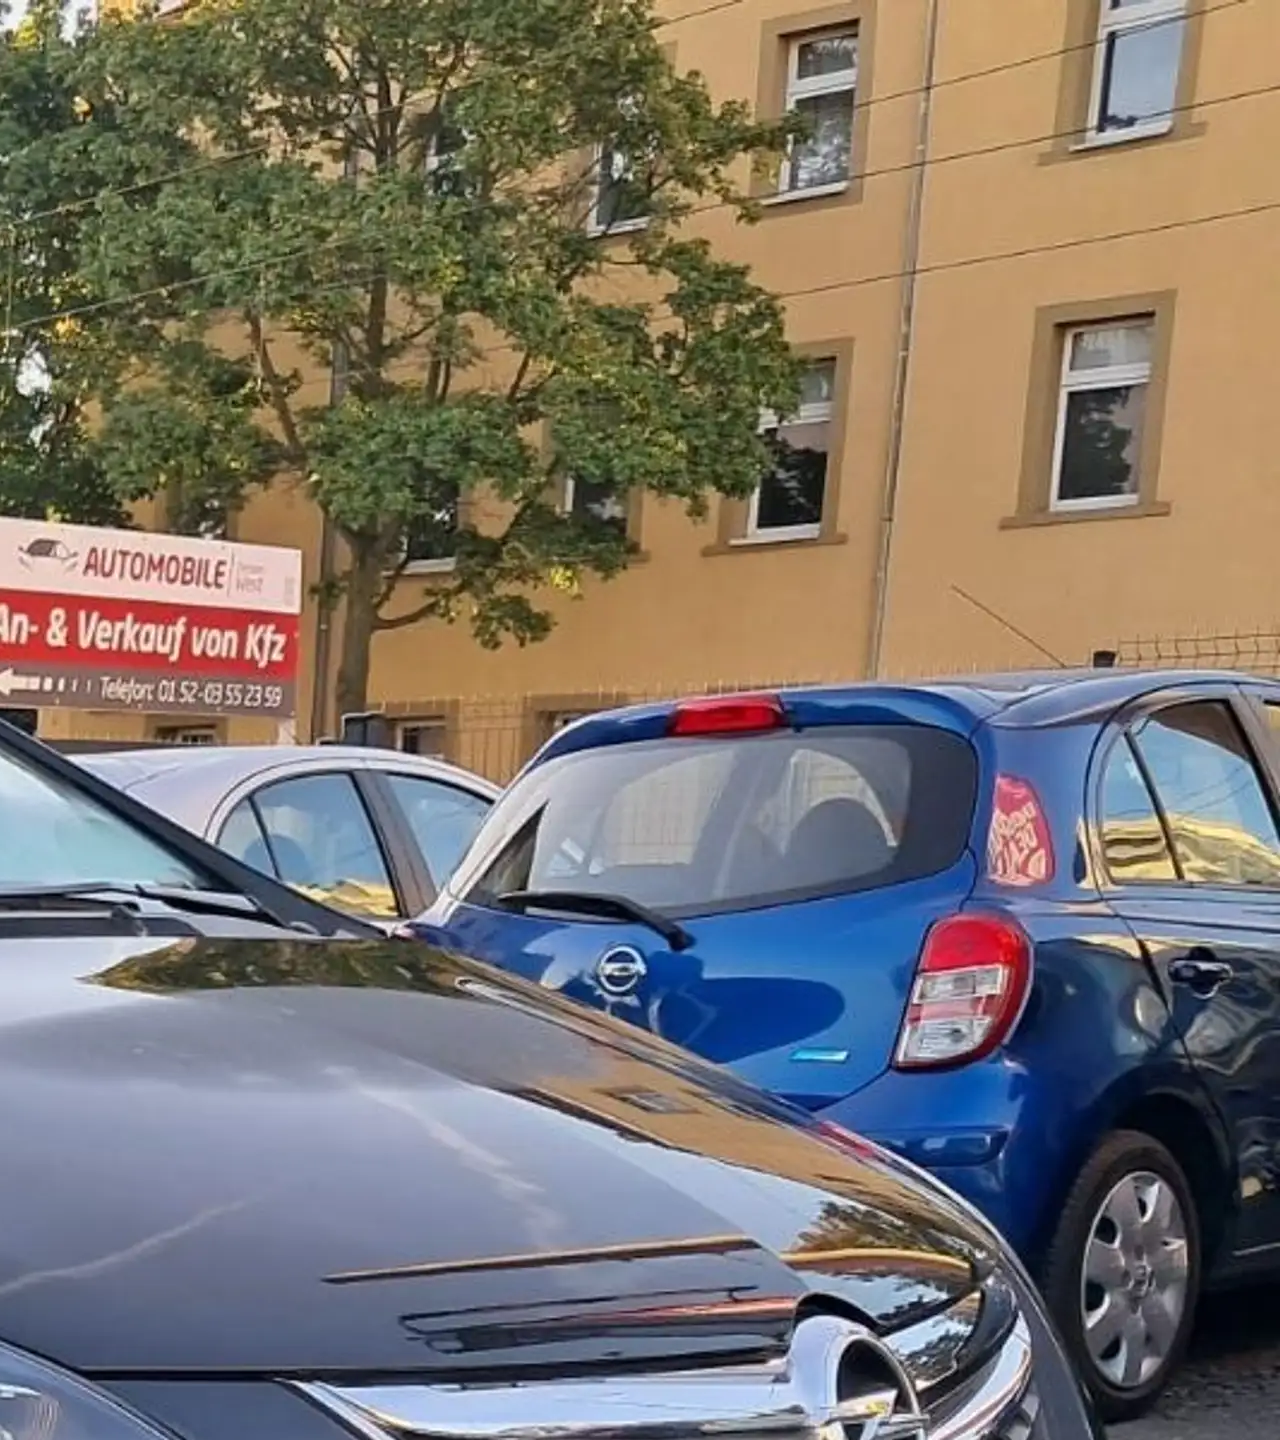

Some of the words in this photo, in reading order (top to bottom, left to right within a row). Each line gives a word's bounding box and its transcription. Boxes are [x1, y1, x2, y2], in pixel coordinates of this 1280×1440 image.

[83, 546, 228, 590] AUTOMOBILE
[46, 607, 67, 648] &
[77, 609, 186, 662] Verkauf
[191, 626, 238, 659] von
[244, 623, 287, 668] Kfz
